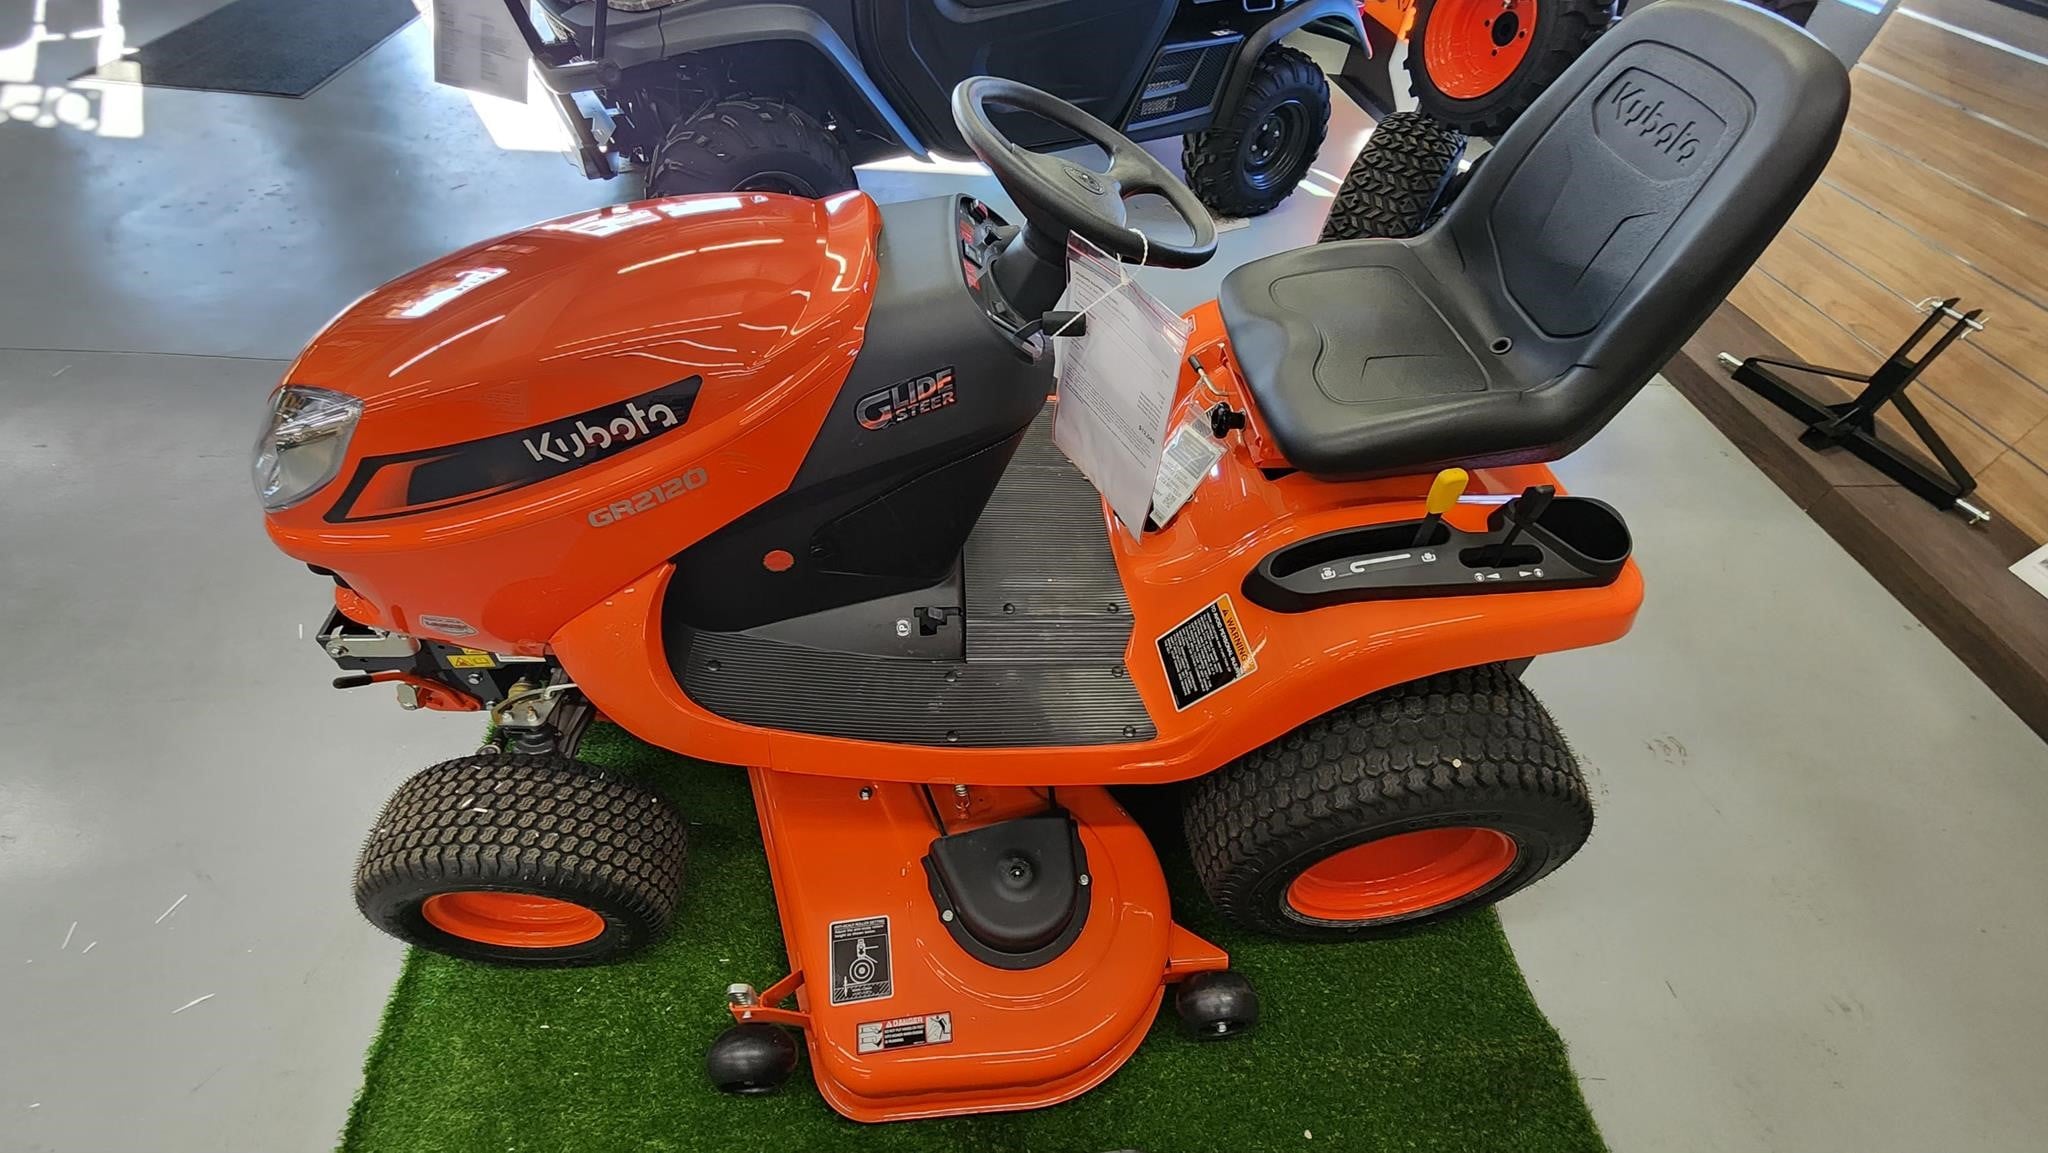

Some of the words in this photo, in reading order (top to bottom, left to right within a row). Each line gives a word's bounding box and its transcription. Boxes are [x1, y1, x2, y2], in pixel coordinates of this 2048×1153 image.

[1611, 81, 1700, 164] Kubota
[856, 369, 953, 430] GLIDE
[896, 391, 956, 422] STEER
[523, 402, 679, 463] Kubota
[587, 467, 709, 528] GR2120
[1214, 612, 1223, 629] AVOID
[1221, 628, 1233, 657] PERSONAL
[1226, 617, 1248, 662] WARNING
[892, 1016, 923, 1028] DANGER
